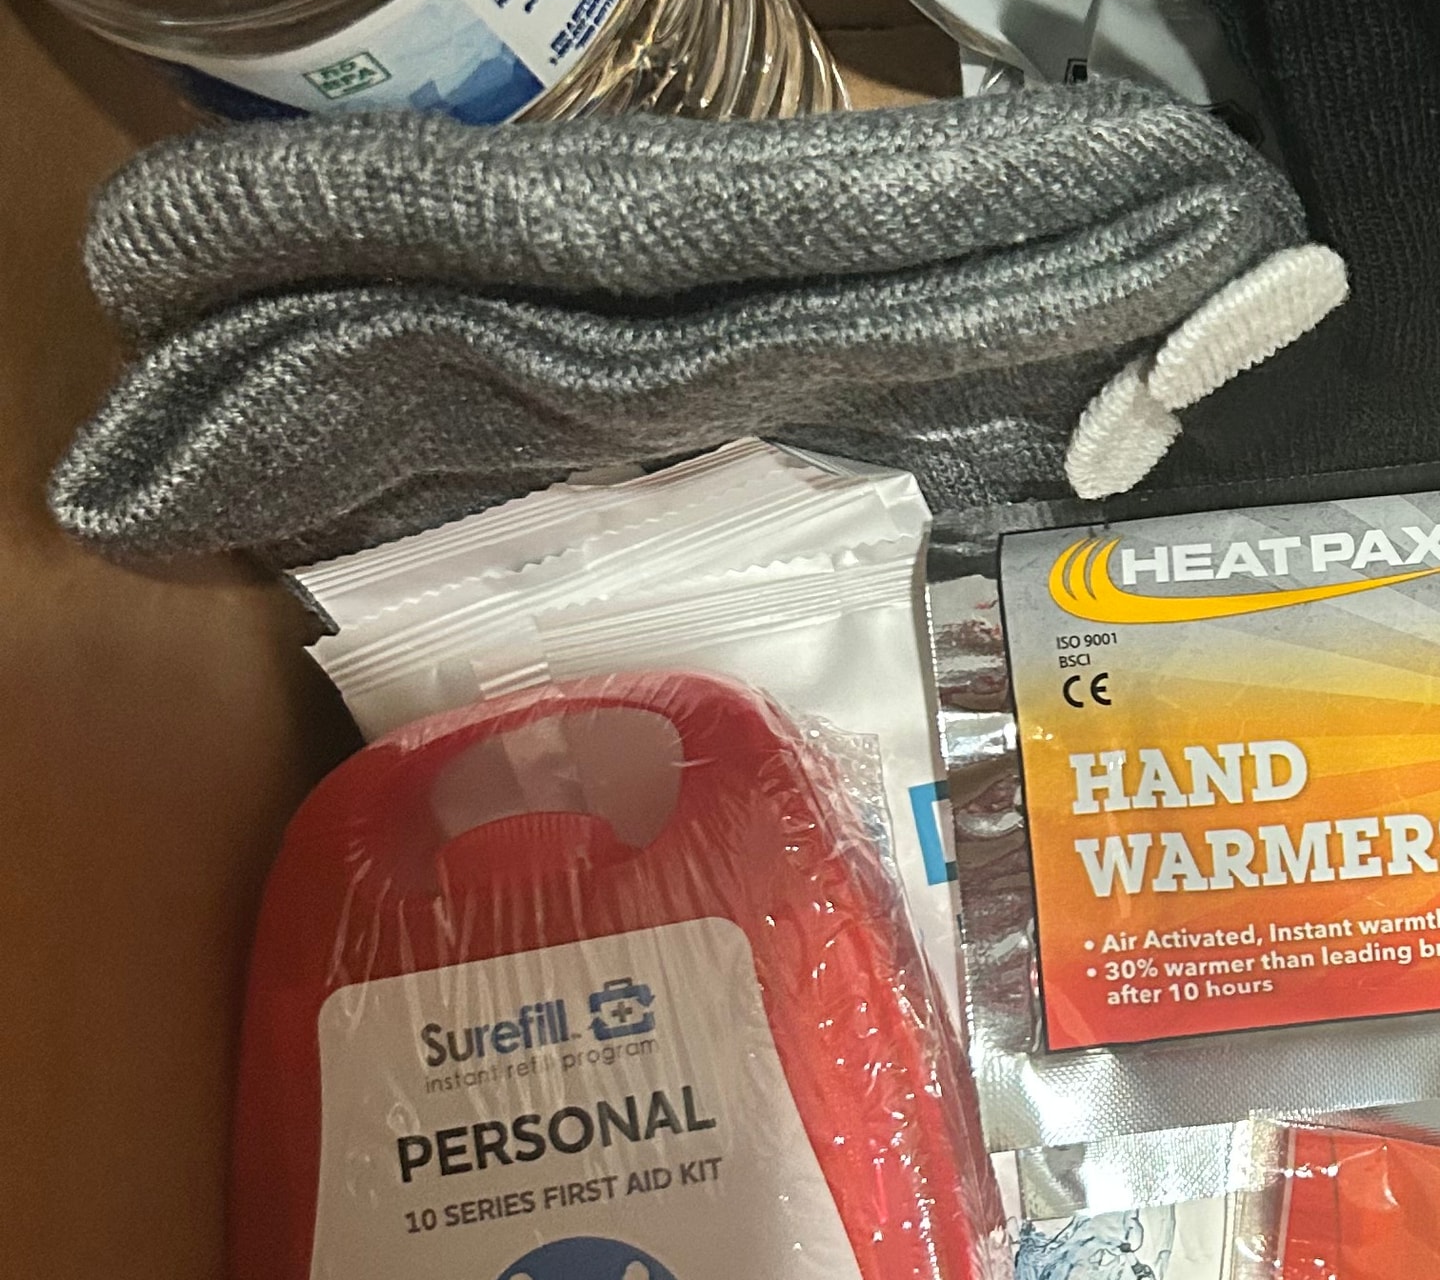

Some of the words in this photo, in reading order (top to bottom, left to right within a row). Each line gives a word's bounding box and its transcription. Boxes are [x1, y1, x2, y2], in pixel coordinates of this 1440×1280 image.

[1056, 635, 1081, 651] ISO
[1083, 631, 1119, 648] 9001
[1058, 654, 1092, 669] BSCI
[1069, 740, 1309, 816] HAND
[1101, 933, 1139, 954] Air
[1143, 924, 1265, 951] Activated,
[1269, 919, 1353, 944] Instant
[1104, 957, 1160, 982] 30%
[1164, 956, 1255, 978] warmer
[1261, 950, 1317, 971] than
[1321, 942, 1413, 967] leading
[1107, 984, 1163, 1007] after
[1168, 982, 1200, 1002] 10
[1205, 976, 1275, 998] hours
[421, 998, 571, 1069] Surefill
[424, 1063, 500, 1095] instant
[561, 1038, 661, 1073] program
[396, 1084, 718, 1184] PERSONAL
[404, 1207, 439, 1236] 10
[444, 1189, 537, 1229] SERIES
[543, 1174, 620, 1211] FIRST
[626, 1167, 673, 1197] AID
[680, 1155, 724, 1188] KIT
